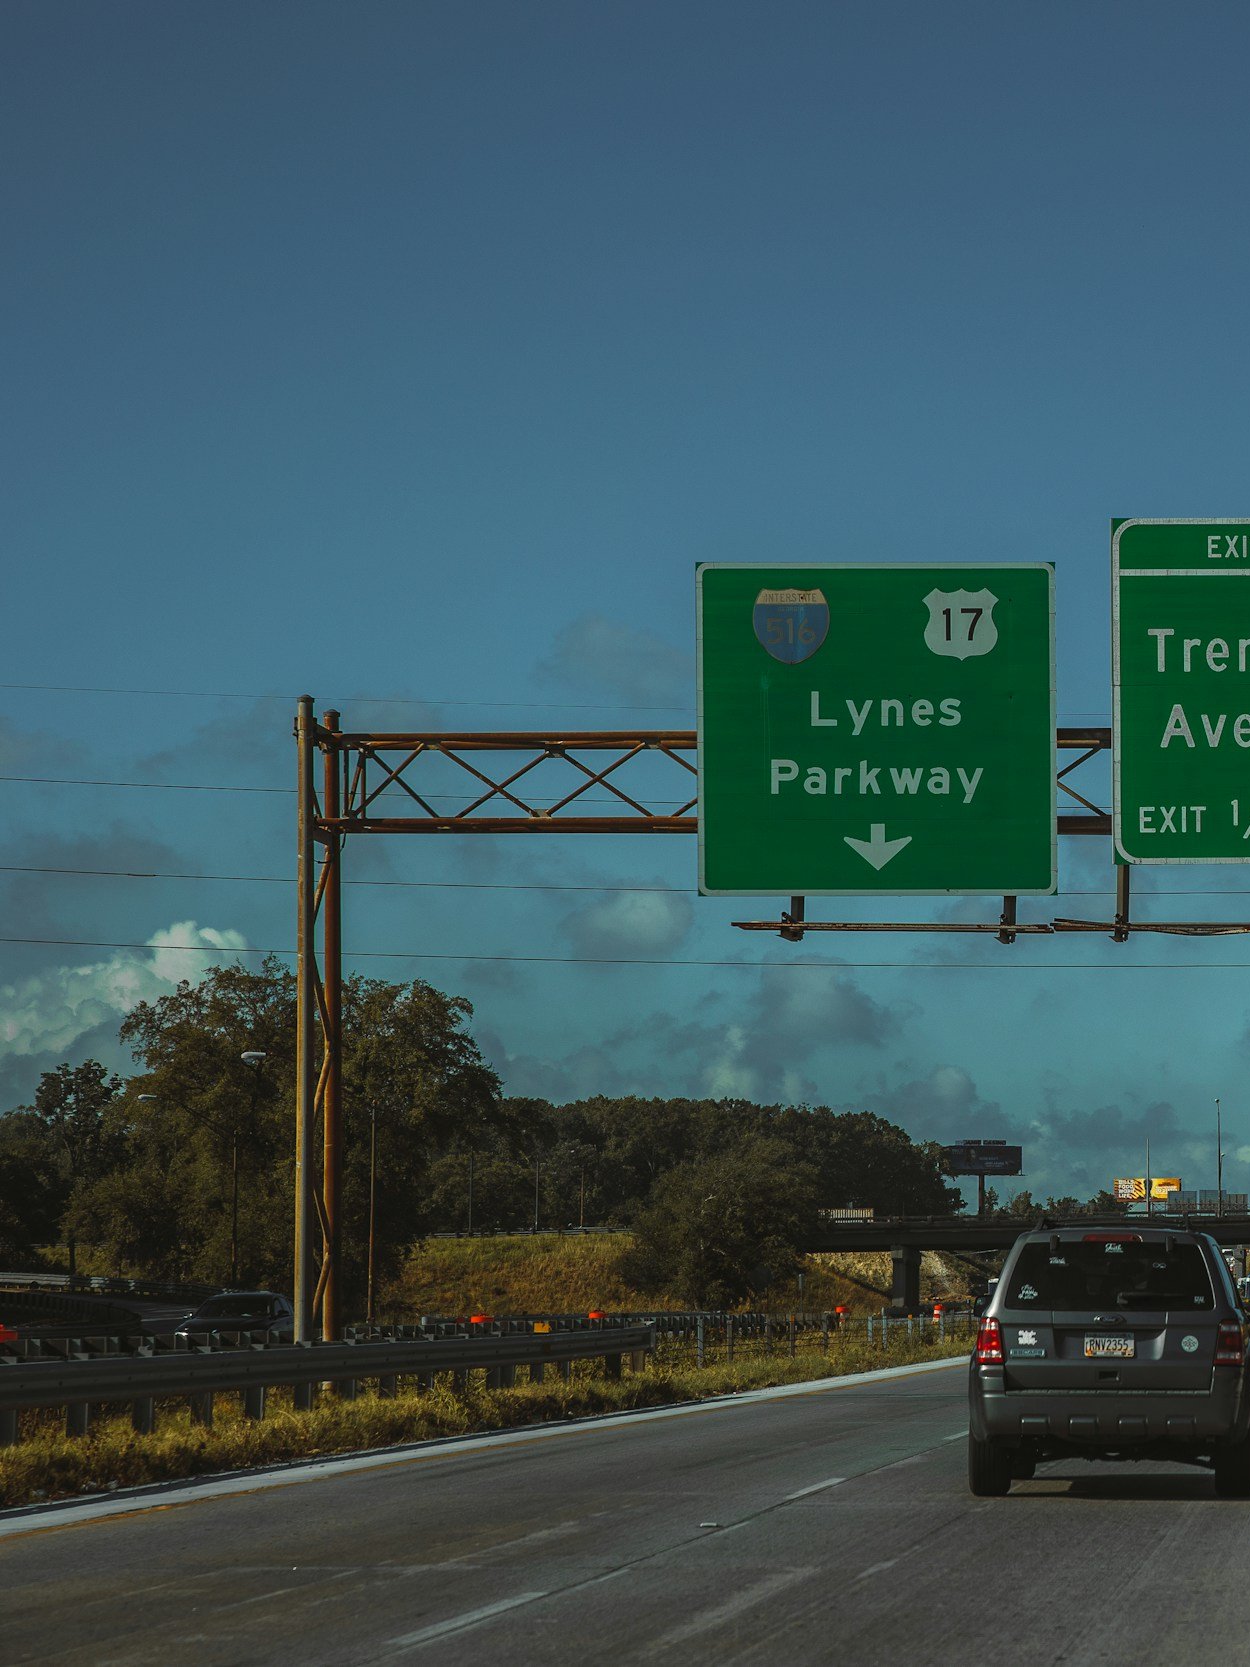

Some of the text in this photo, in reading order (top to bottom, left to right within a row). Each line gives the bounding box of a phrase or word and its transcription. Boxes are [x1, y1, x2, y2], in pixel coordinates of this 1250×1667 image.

[765, 593, 817, 603] INTERSTATE
[767, 617, 817, 645] 516
[943, 608, 983, 641] 17
[811, 691, 961, 735] Lynes
[771, 759, 983, 803] Parkway
[1140, 806, 1206, 833] EXIT
[1089, 1339, 1129, 1351] RNV2355
